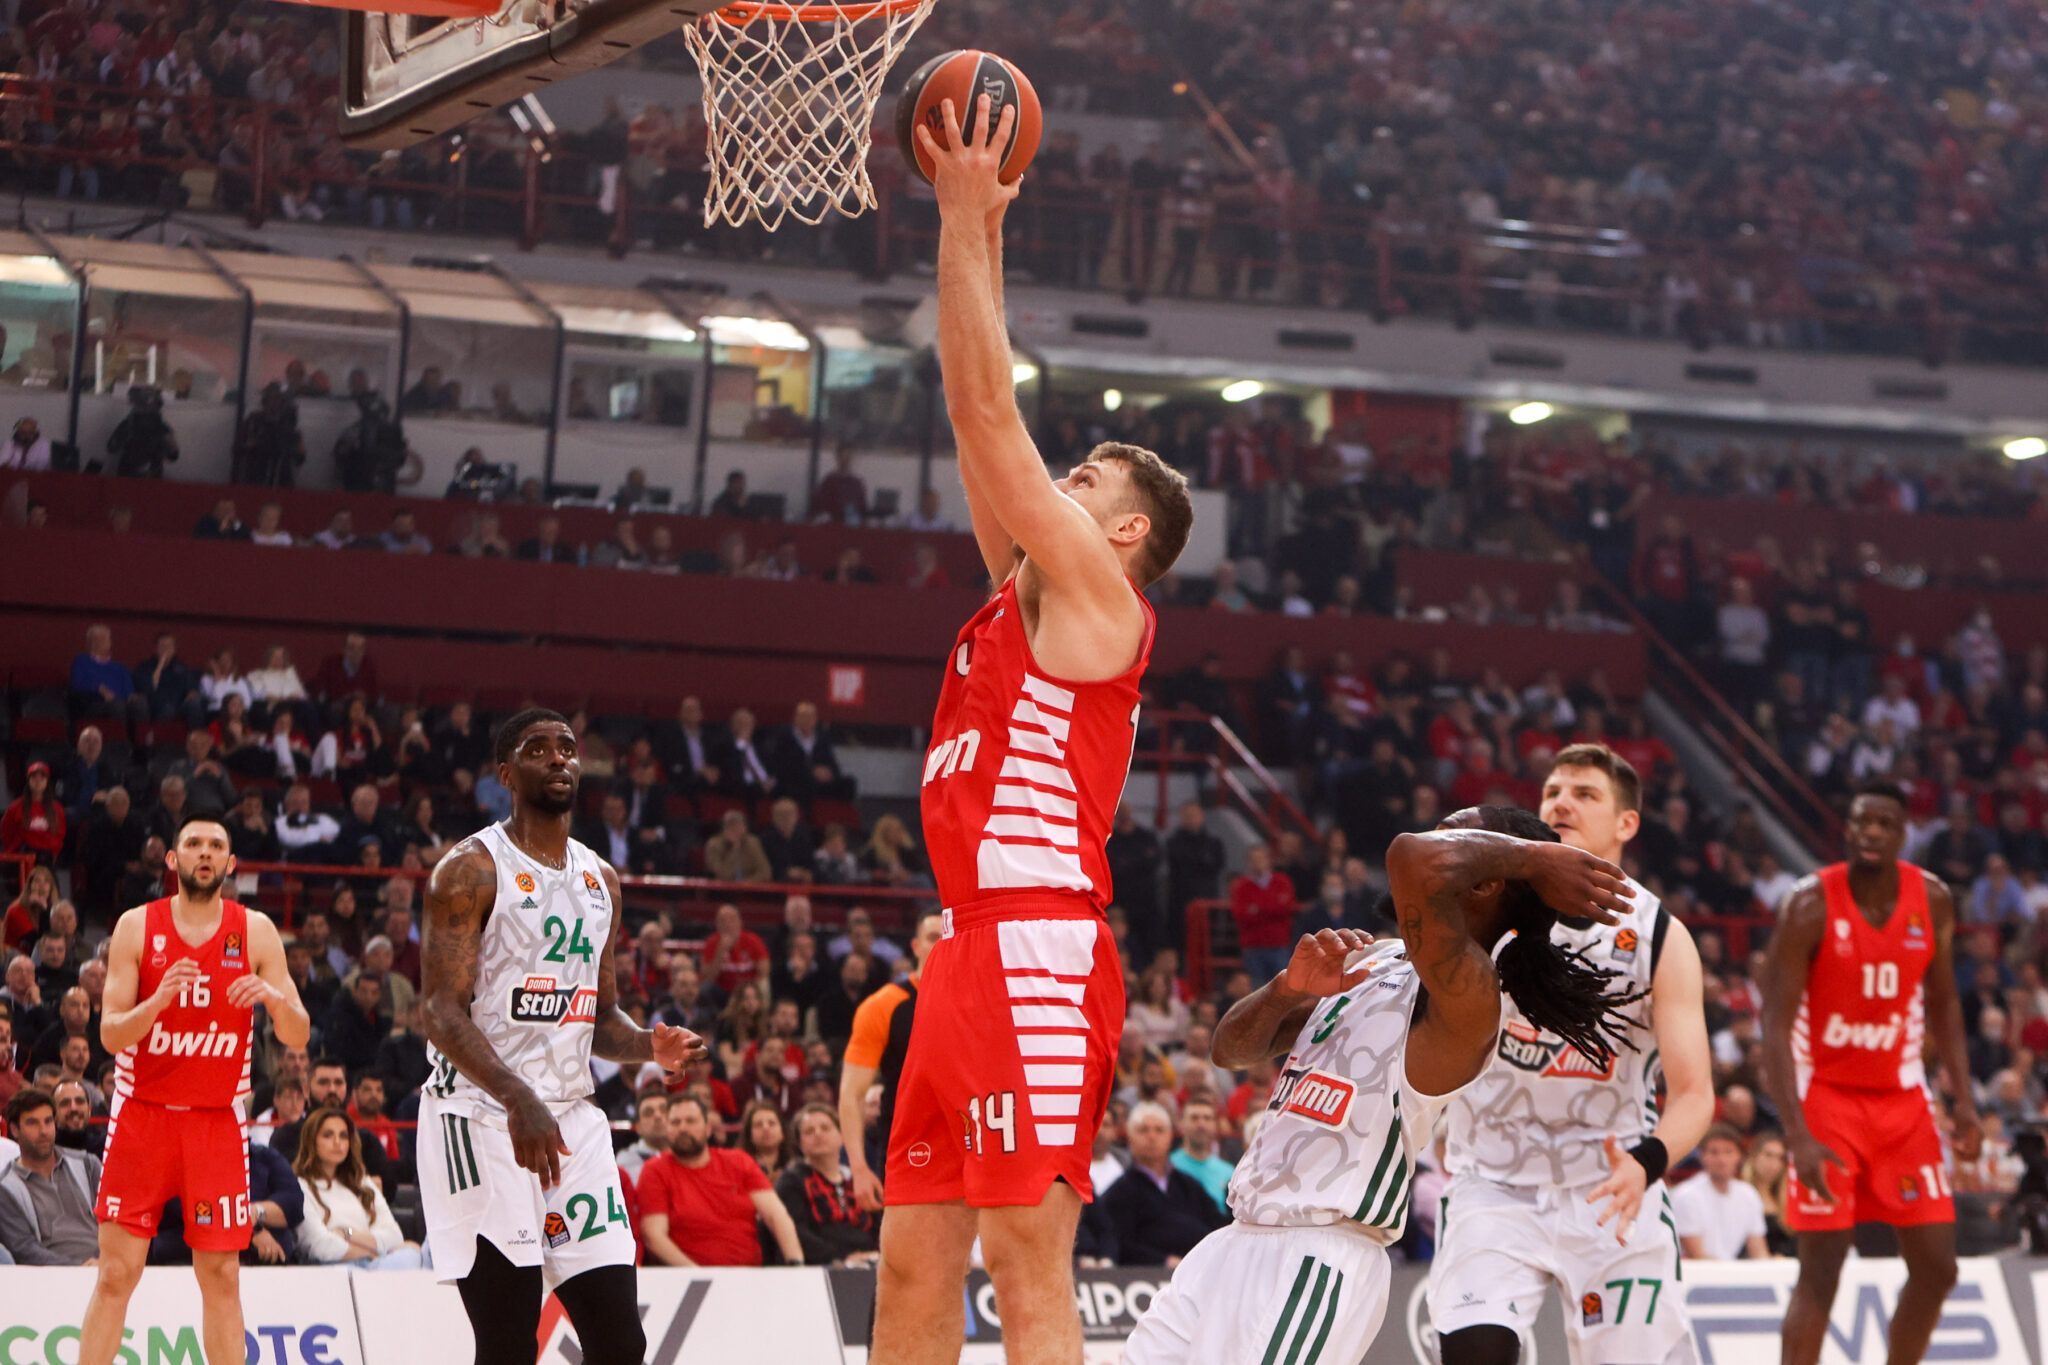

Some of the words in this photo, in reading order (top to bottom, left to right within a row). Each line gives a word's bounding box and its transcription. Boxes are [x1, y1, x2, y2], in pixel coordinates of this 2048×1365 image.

[921, 729, 981, 787] win
[543, 915, 593, 963] 24
[178, 975, 212, 1008] 16
[1861, 962, 1899, 998] 10
[148, 1020, 238, 1058] bwin
[967, 1091, 1016, 1155] 14
[218, 1193, 248, 1229] 16
[566, 1186, 629, 1243] 24
[1605, 1278, 1662, 1325] 77
